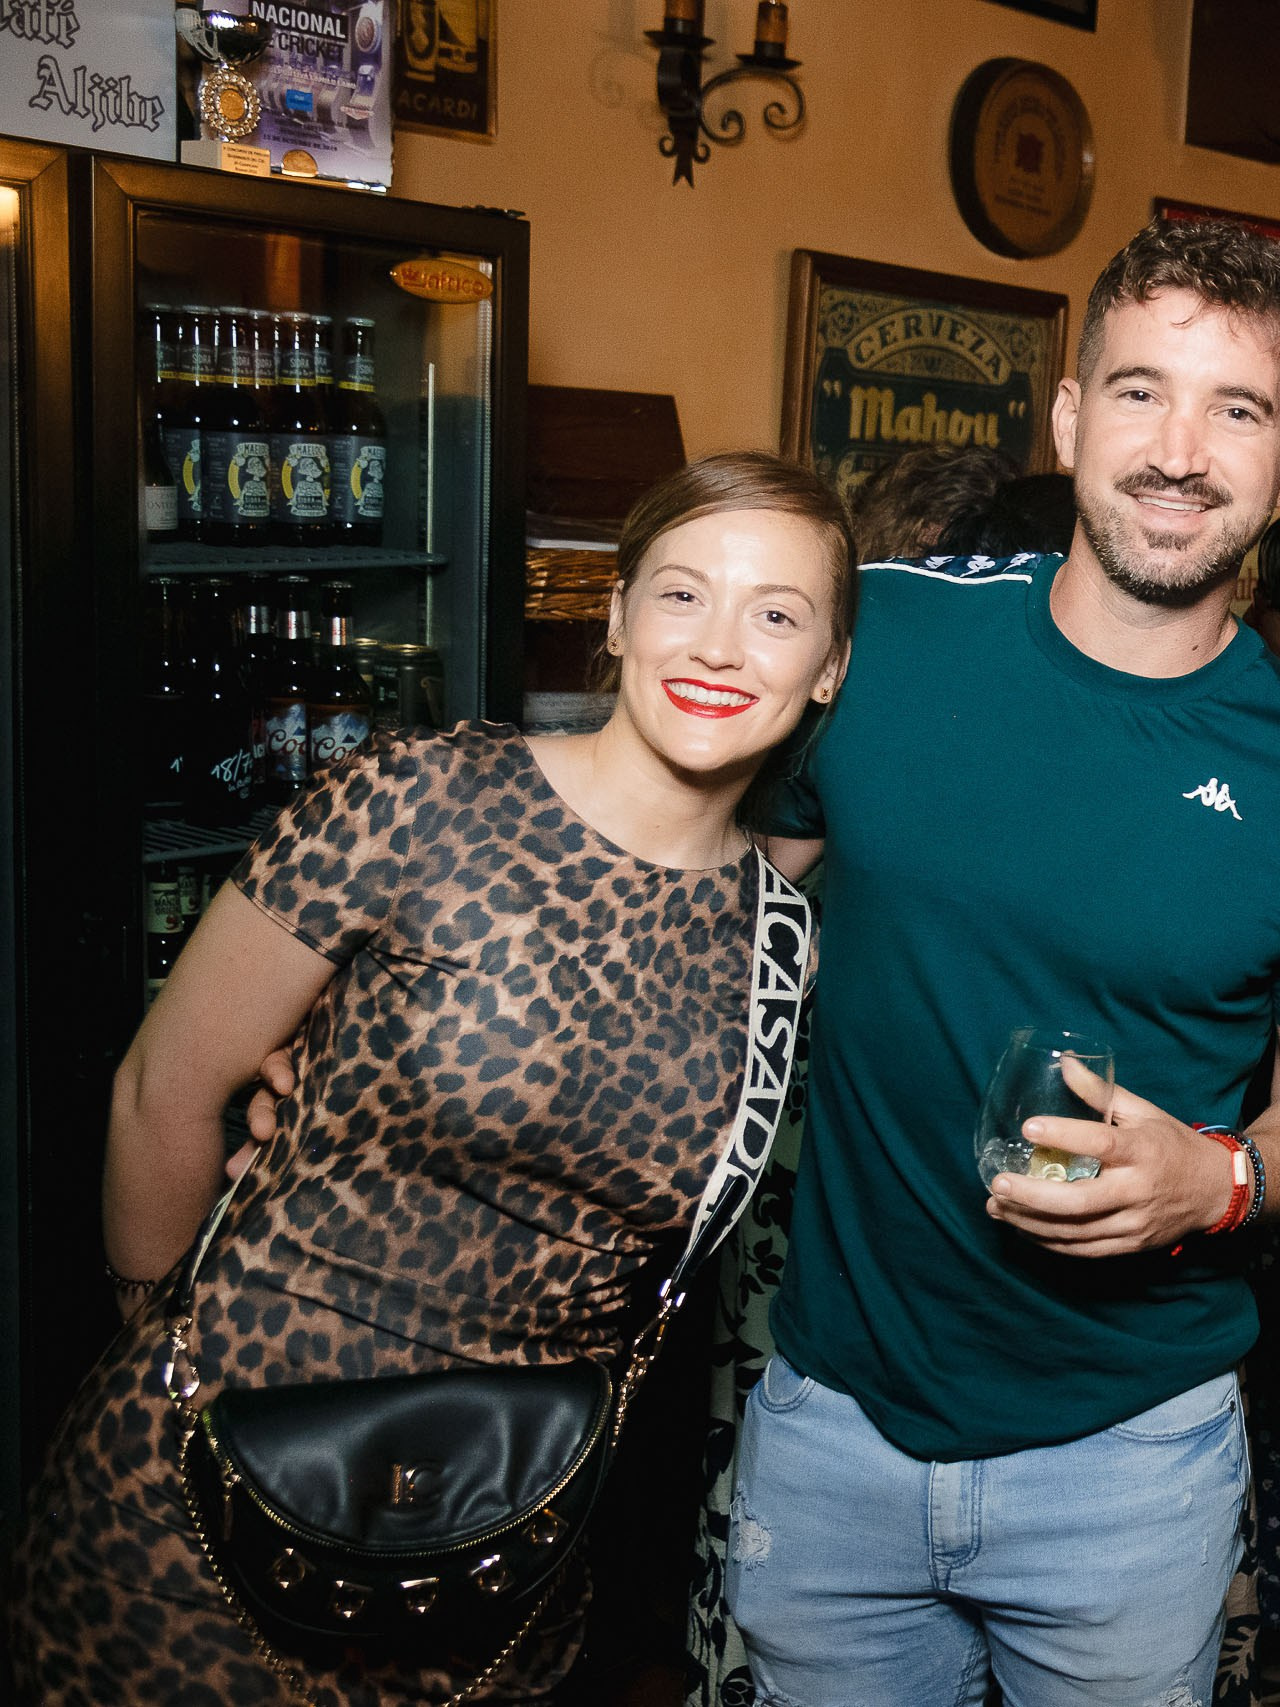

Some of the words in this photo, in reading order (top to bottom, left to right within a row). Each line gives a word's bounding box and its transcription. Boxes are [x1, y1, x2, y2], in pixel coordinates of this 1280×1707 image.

[252, 1, 346, 39] NACIONAL
[278, 32, 345, 61] CRICKET
[29, 54, 165, 132] Aljibe
[397, 89, 478, 119] ACARDI
[855, 312, 1004, 382] CERVEZA
[313, 736, 350, 762] Co
